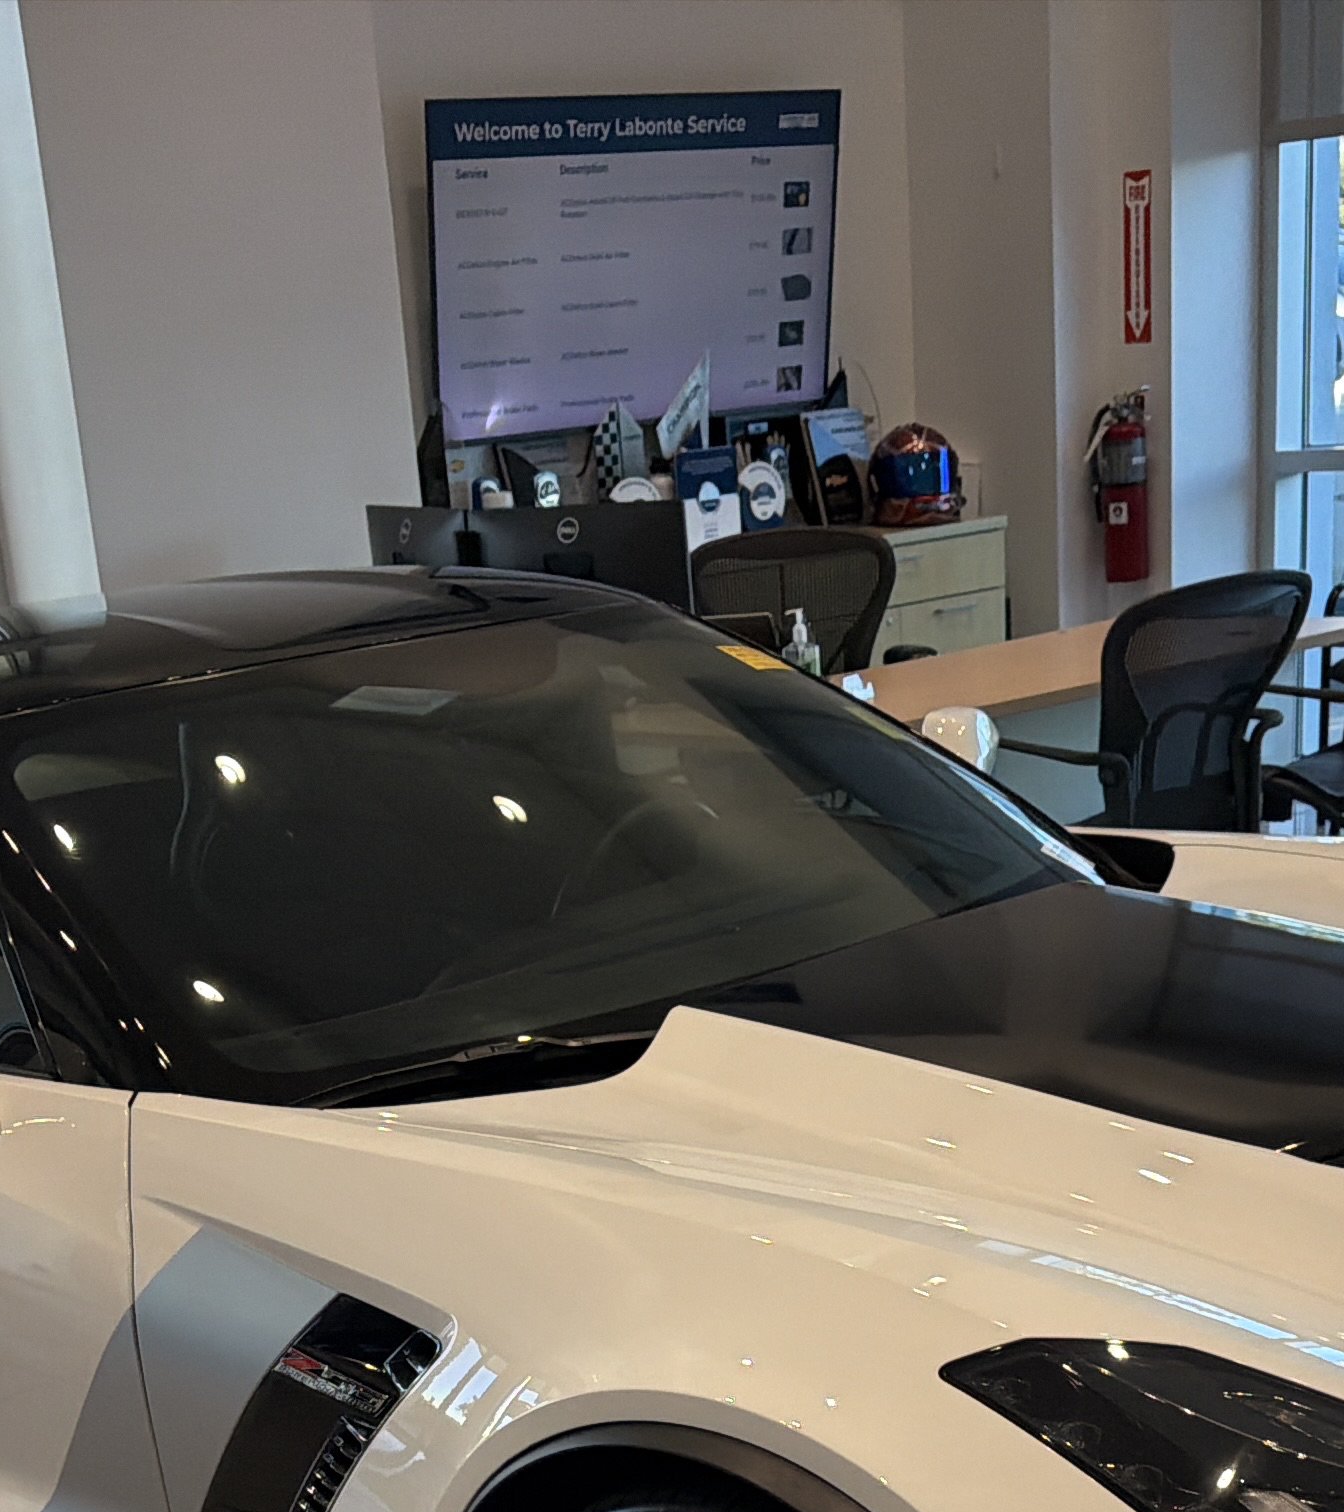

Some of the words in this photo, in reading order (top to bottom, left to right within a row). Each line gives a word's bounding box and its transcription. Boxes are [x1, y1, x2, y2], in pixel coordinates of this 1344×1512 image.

[454, 121, 540, 142] Welcome
[544, 121, 563, 138] to
[566, 118, 610, 141] Terry
[615, 115, 684, 136] Labonte
[687, 113, 747, 133] Service
[455, 167, 489, 180] Service
[559, 162, 609, 176] Description
[751, 155, 772, 166] Price
[1128, 184, 1147, 201] FIRE
